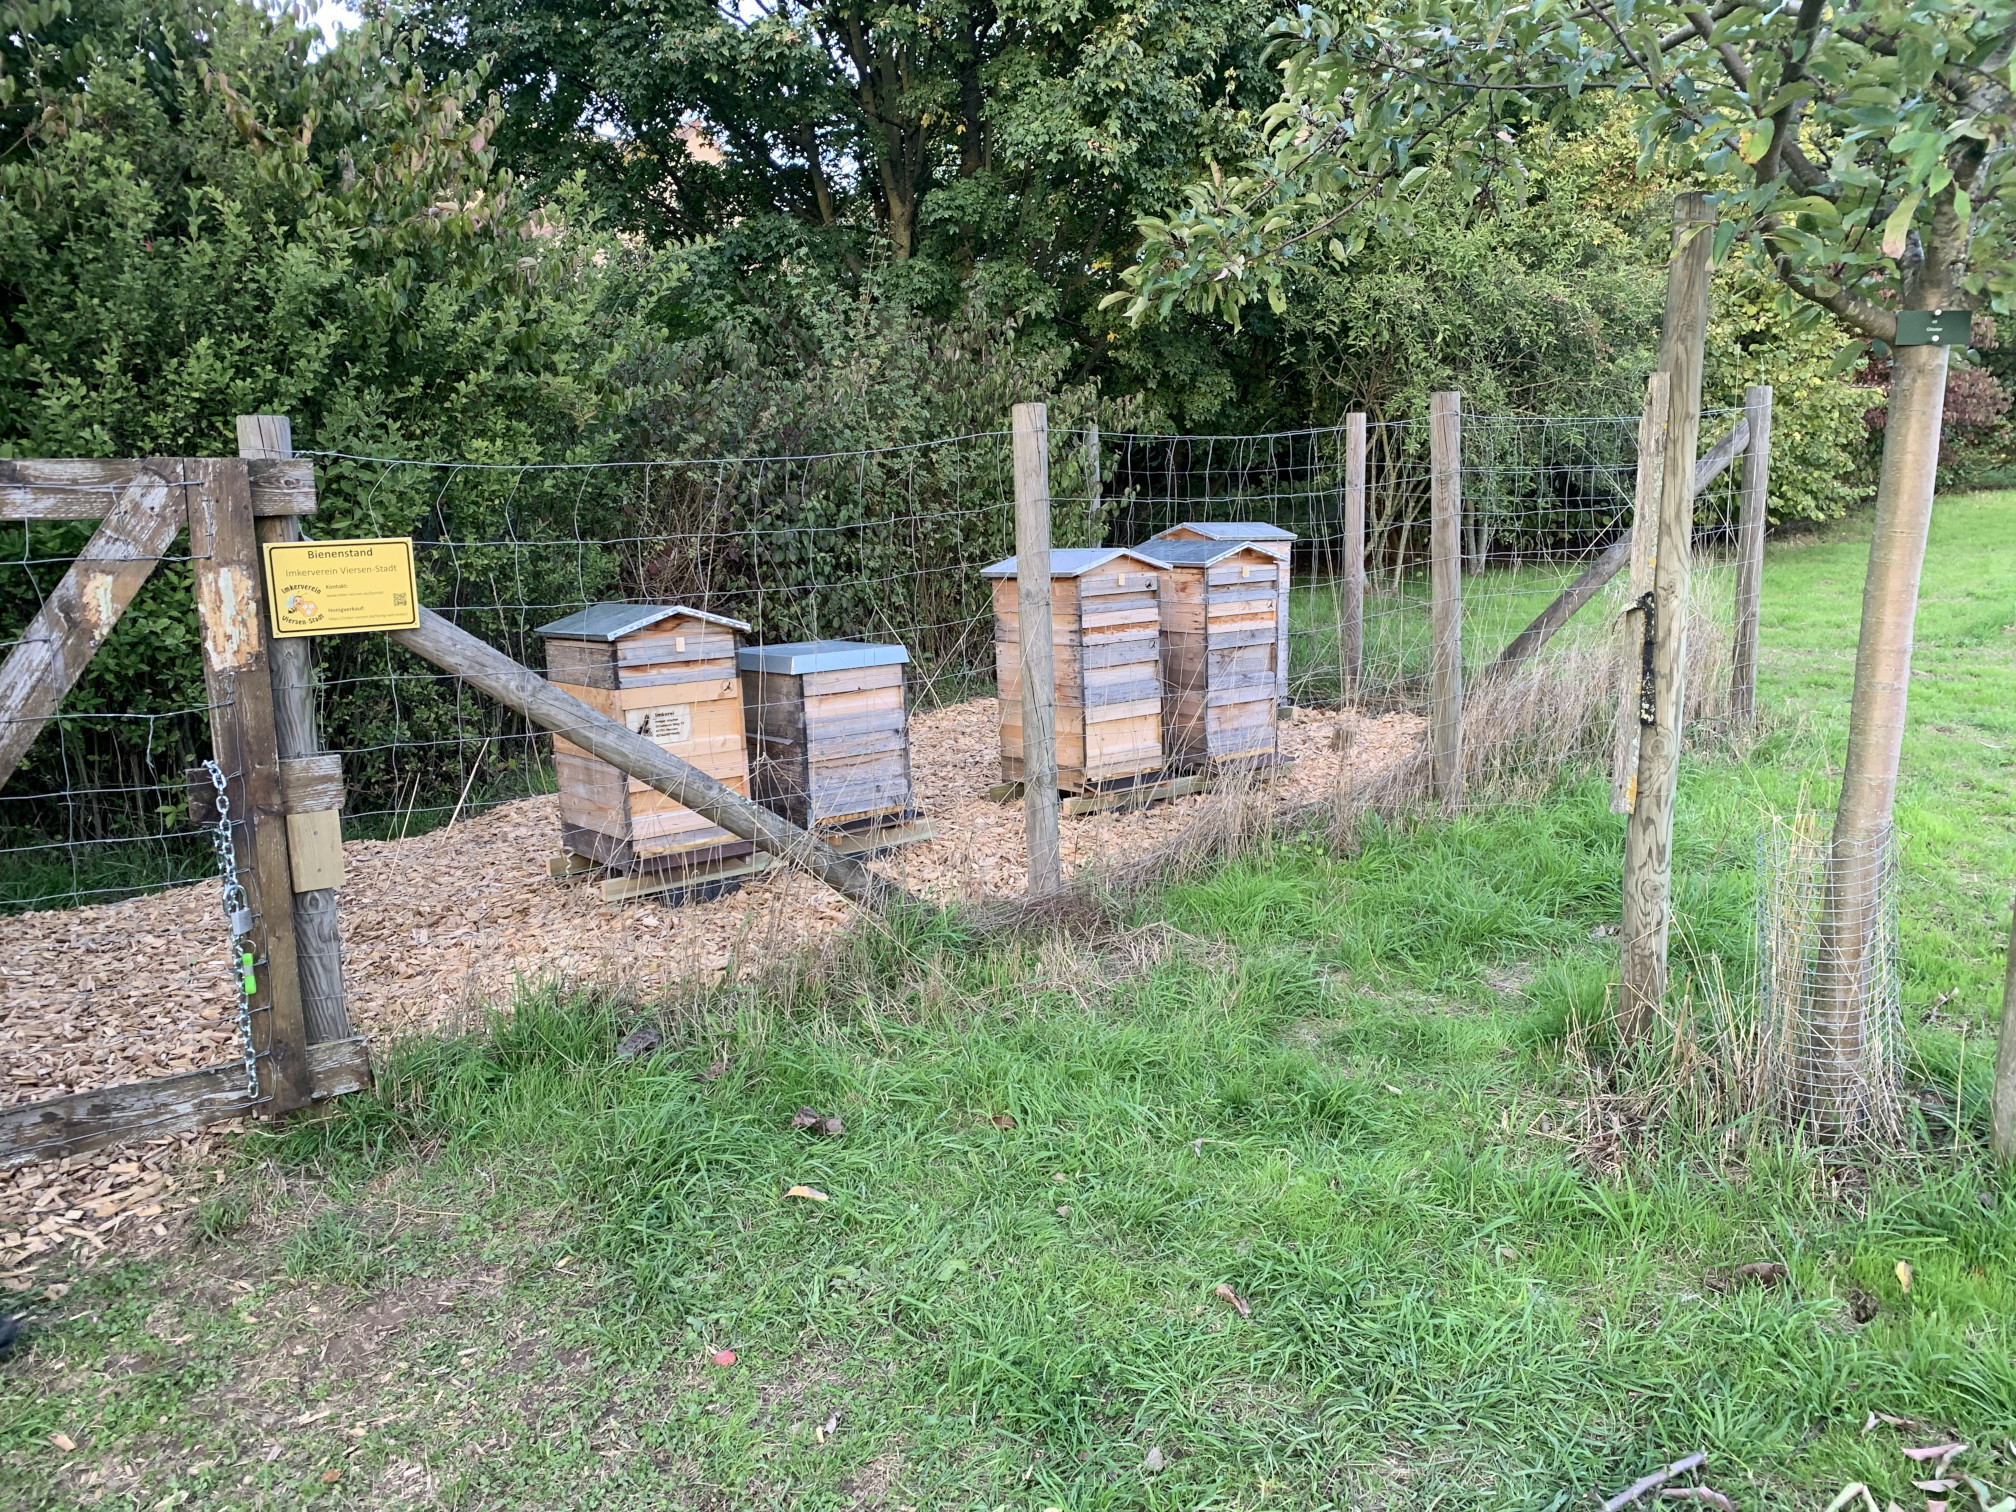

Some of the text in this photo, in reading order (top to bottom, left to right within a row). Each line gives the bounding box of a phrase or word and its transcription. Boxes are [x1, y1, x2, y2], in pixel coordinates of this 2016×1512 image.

[307, 548, 373, 559] Bienenstand
[285, 564, 397, 577] Imkerverein Viersen-Stadt
[281, 583, 322, 595] Imkerverein
[328, 606, 366, 614] Honigverkauf:
[282, 613, 325, 625] Viersen-Stadt
